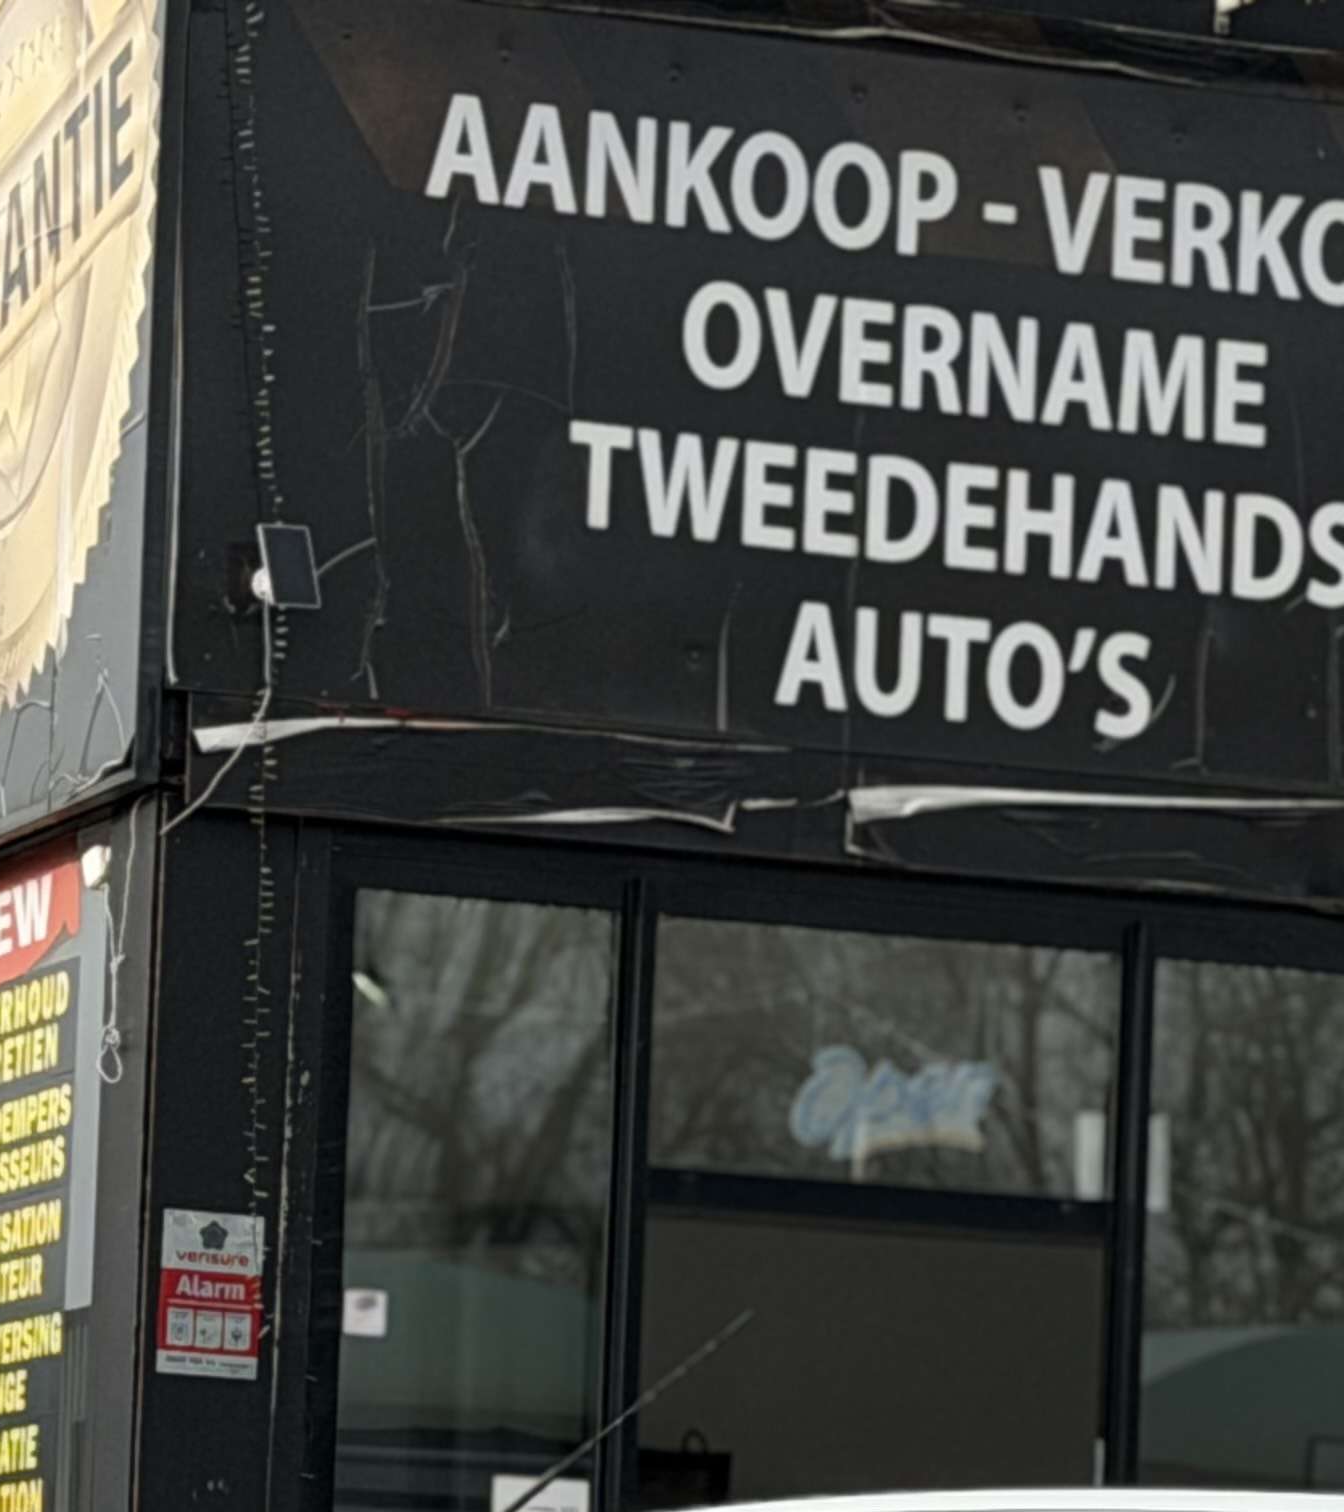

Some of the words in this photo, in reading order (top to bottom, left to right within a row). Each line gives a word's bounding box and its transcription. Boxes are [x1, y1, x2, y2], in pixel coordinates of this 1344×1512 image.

[425, 93, 958, 255] AANKOOP
[682, 281, 1268, 447] OVERNAME
[176, 1250, 249, 1267] verisure
[176, 1274, 245, 1300] Alarm
